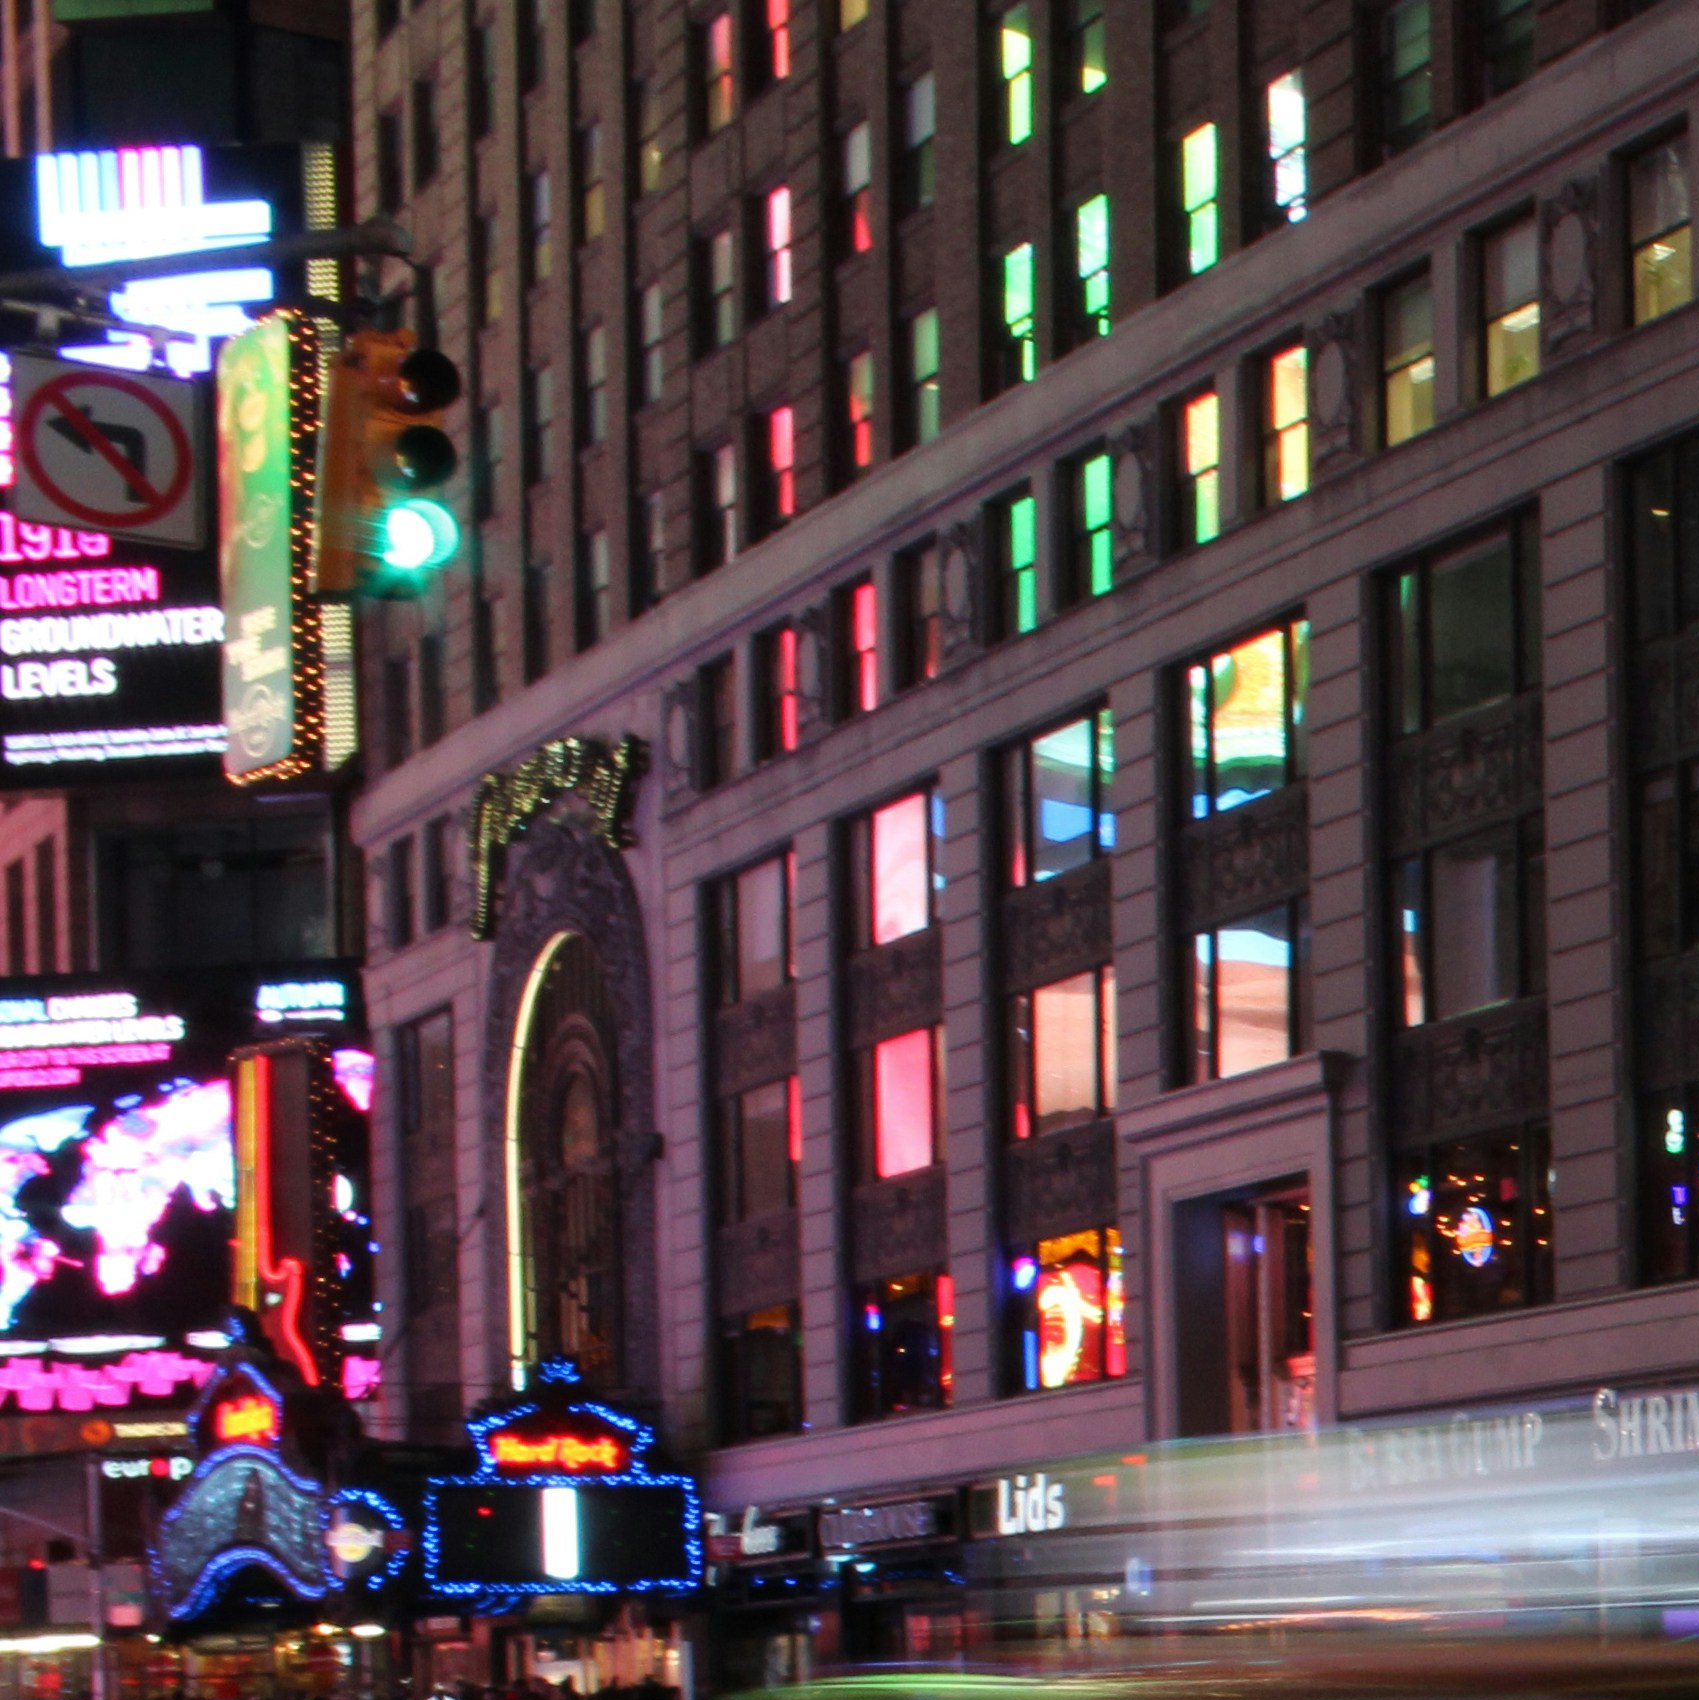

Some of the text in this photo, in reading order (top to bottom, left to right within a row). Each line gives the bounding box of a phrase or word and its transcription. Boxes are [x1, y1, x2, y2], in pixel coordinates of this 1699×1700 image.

[0, 567, 160, 610] LONGTERM
[0, 605, 225, 656] GROUNDWATER
[0, 658, 118, 699] LEVELS
[997, 1472, 1066, 1535] Lids
